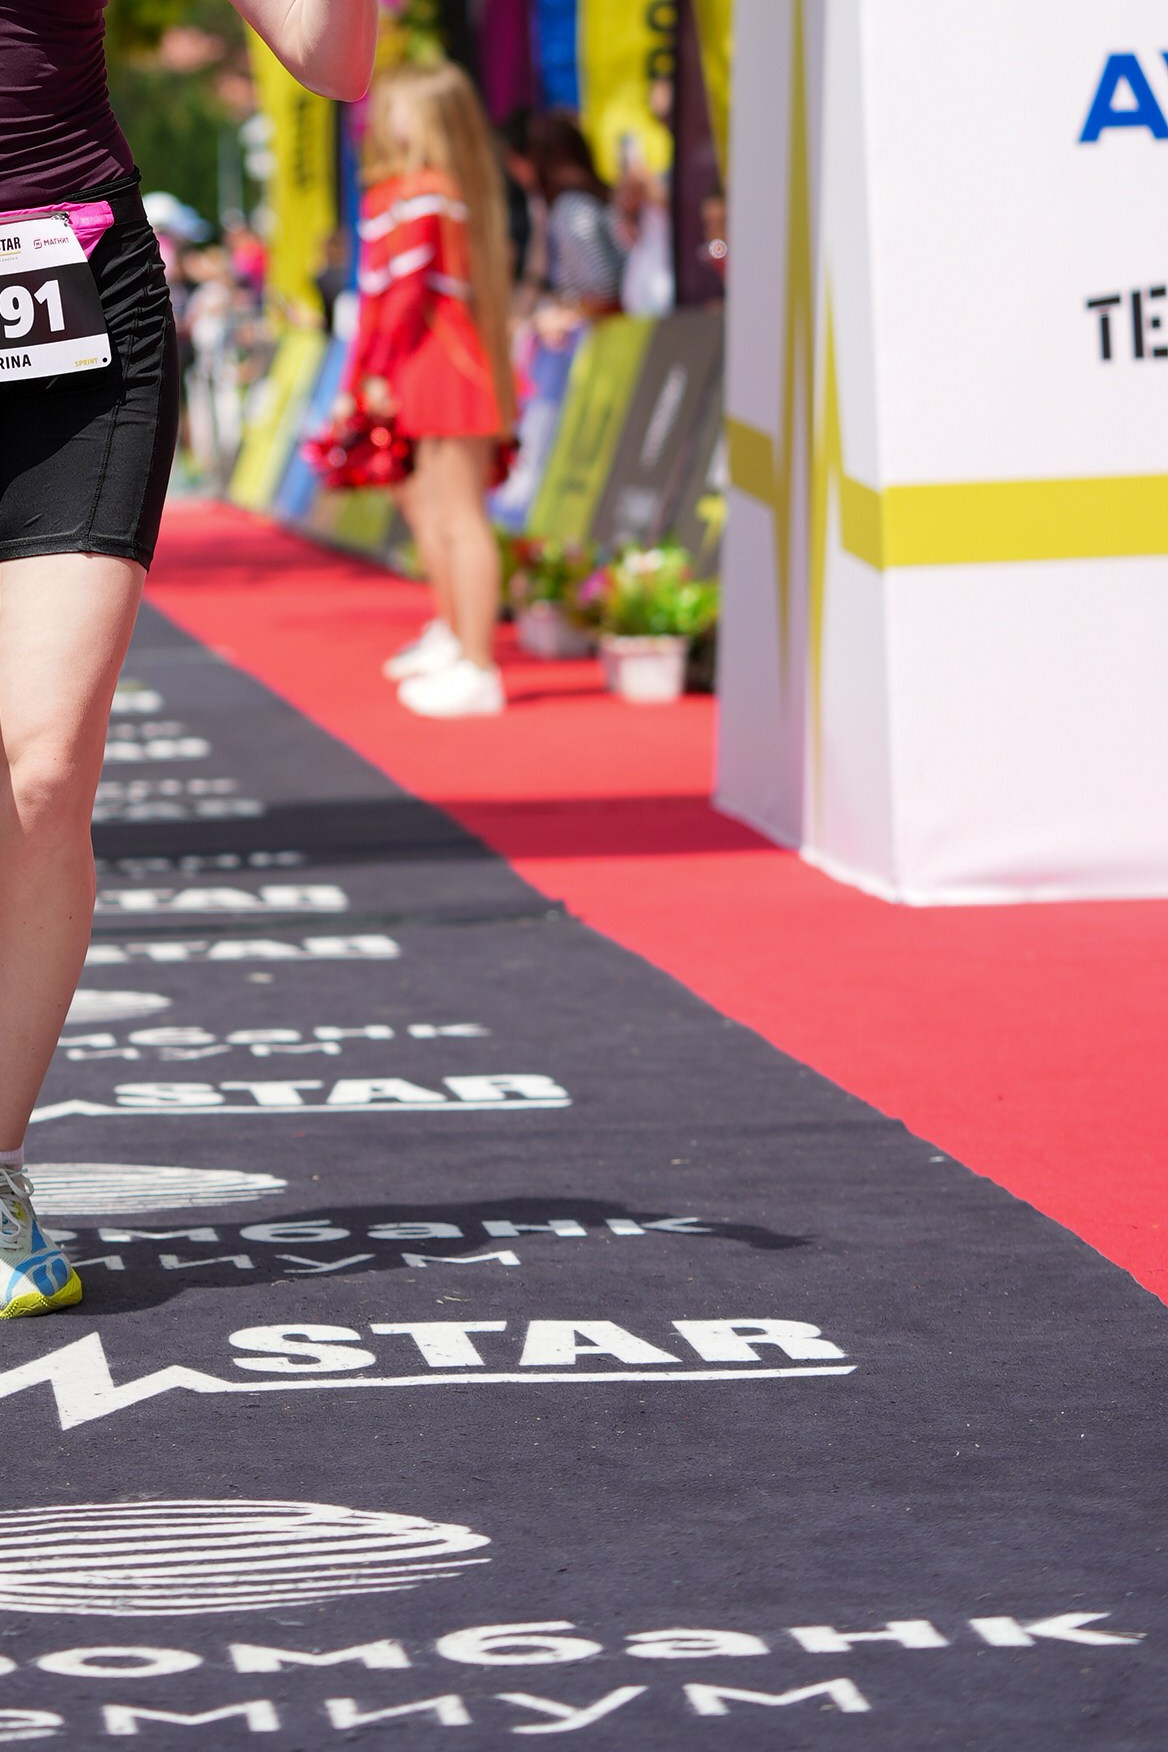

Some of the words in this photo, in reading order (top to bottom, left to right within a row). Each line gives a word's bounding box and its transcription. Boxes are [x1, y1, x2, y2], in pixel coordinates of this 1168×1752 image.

[74, 357, 99, 367] SPRINT
[115, 1074, 569, 1107] STAR
[228, 1318, 848, 1374] STAR
